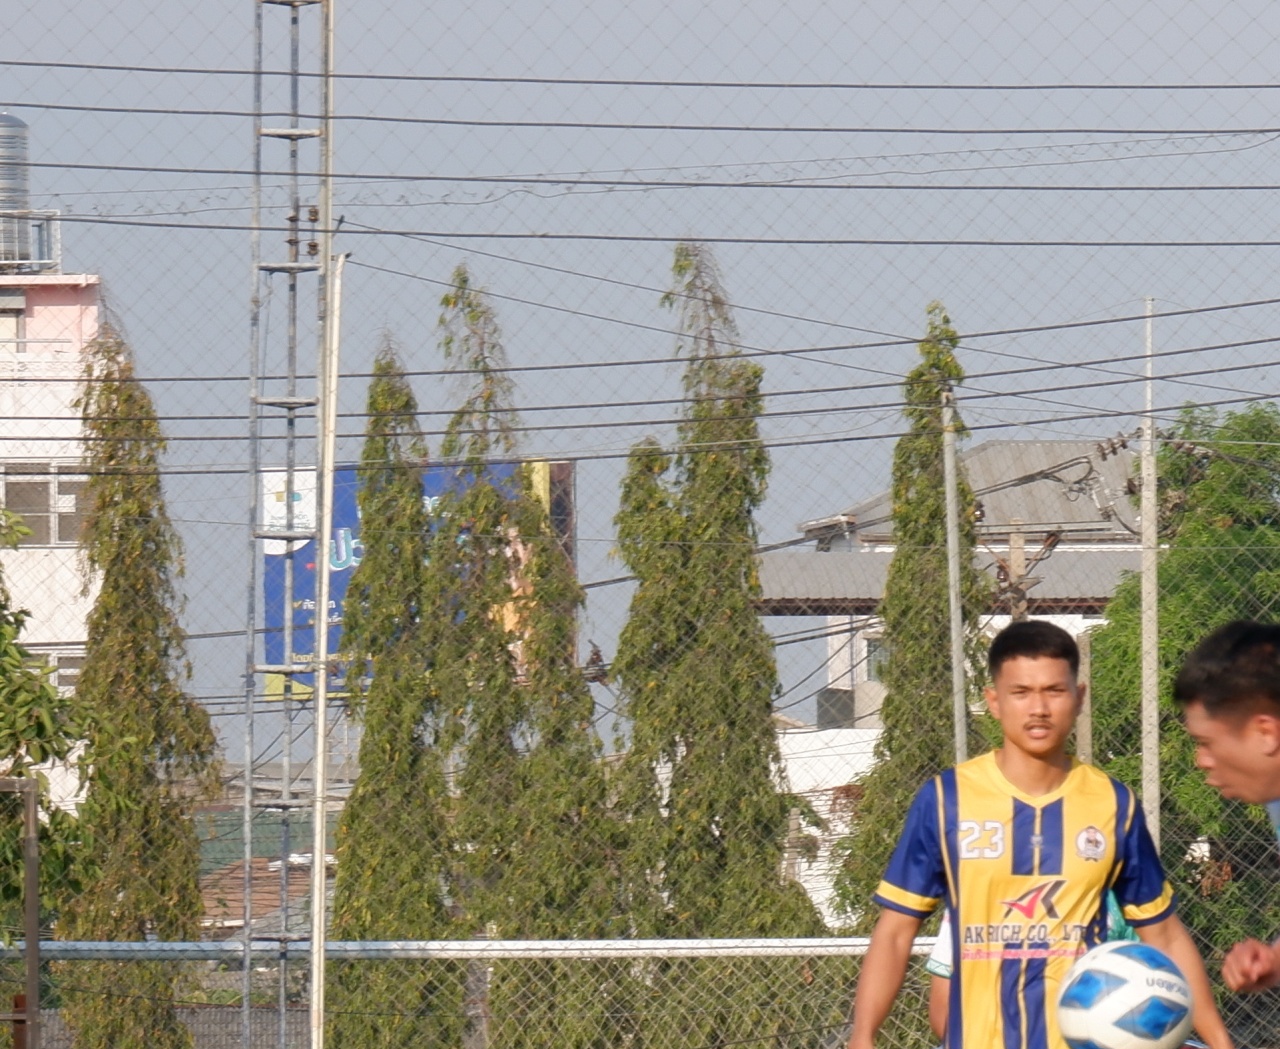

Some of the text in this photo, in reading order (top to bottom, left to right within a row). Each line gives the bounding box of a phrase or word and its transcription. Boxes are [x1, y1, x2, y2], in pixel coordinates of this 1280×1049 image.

[958, 821, 1004, 859] 23
[964, 926, 985, 944] AK
[987, 924, 1023, 943] RICH
